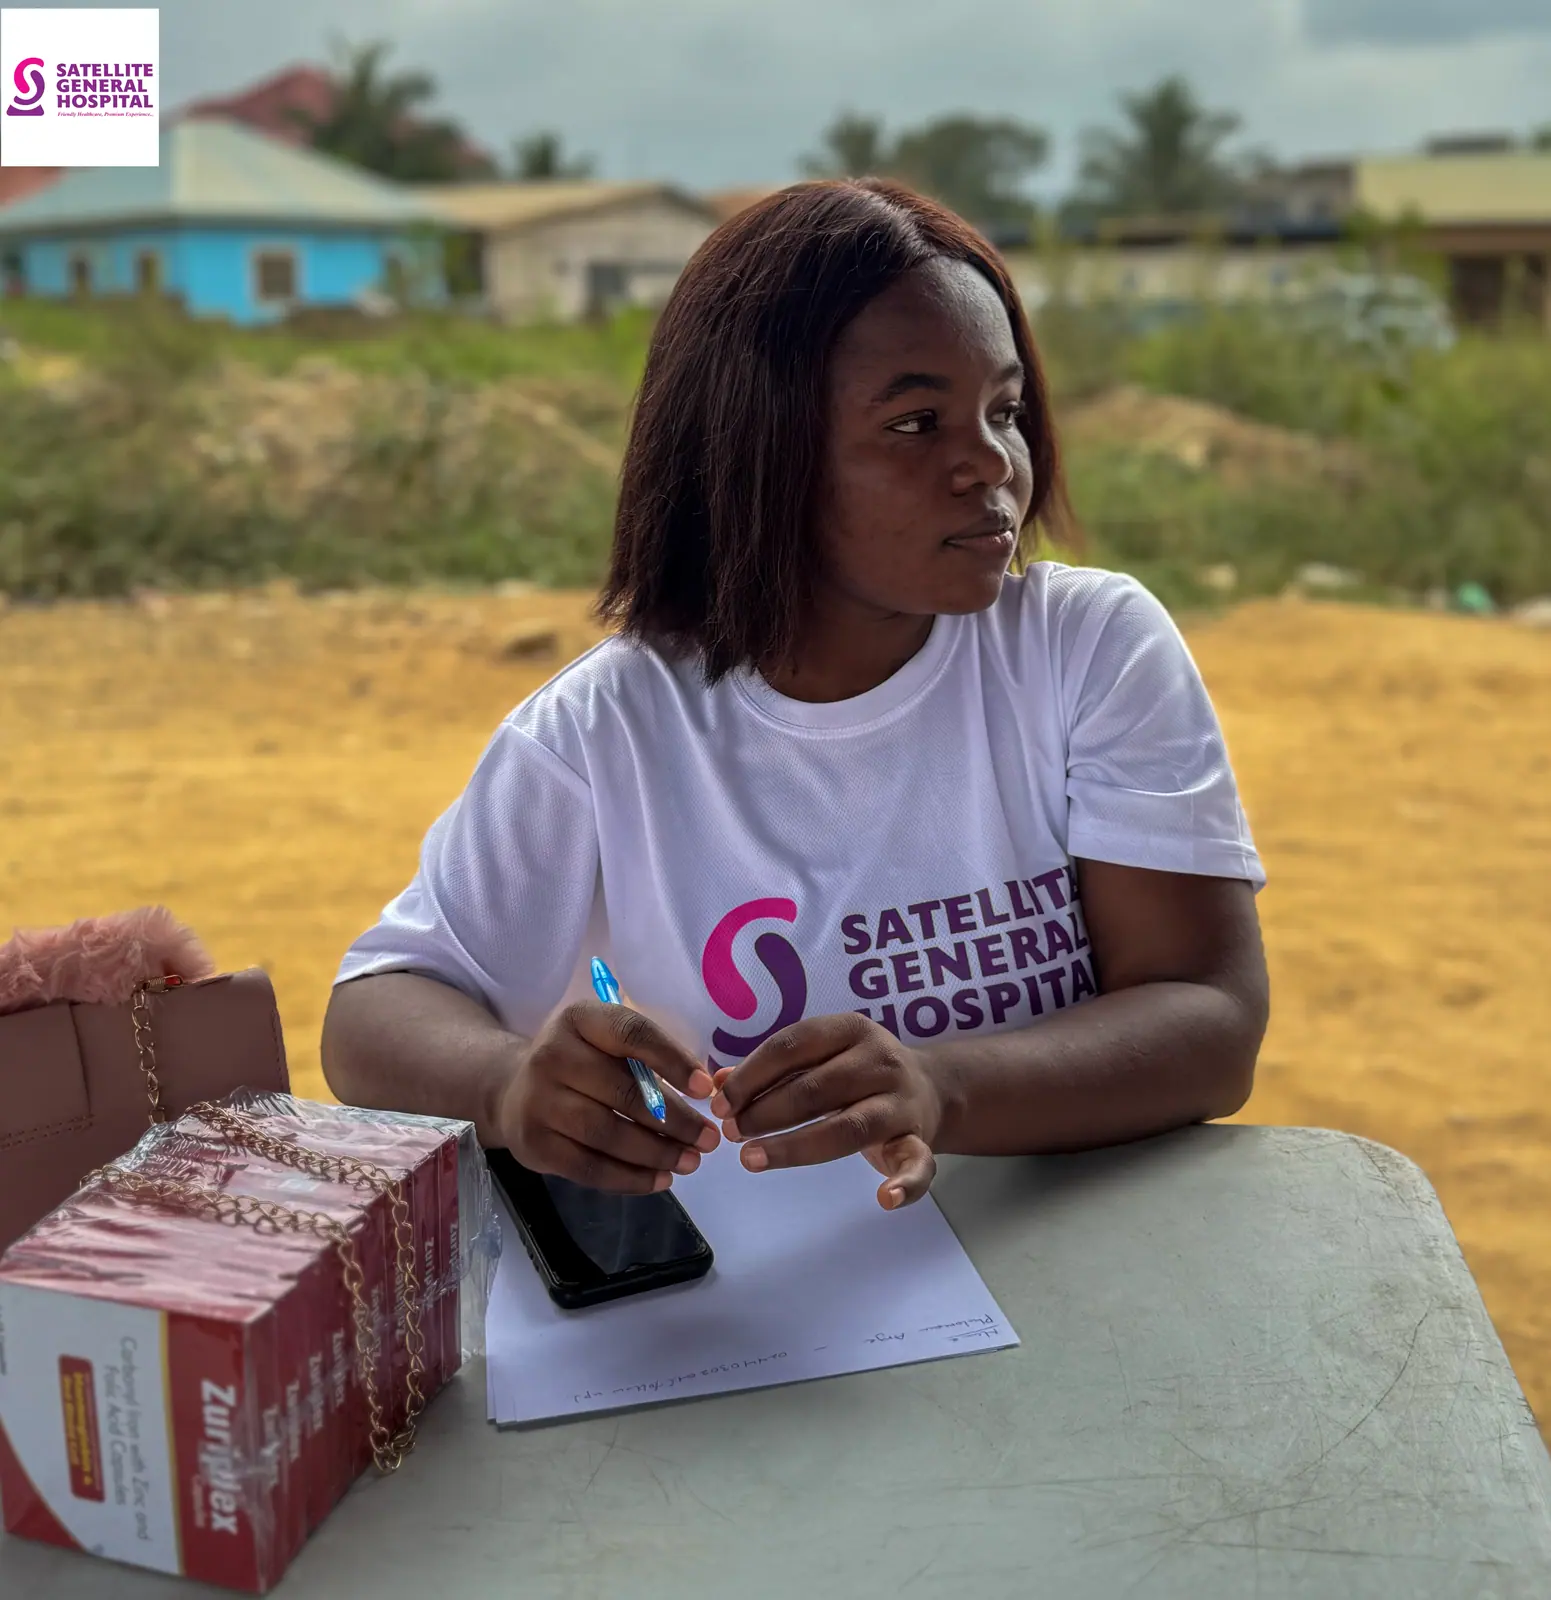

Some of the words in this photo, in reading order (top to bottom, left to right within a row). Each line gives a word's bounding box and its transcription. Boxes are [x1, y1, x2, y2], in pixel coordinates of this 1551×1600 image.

[848, 912, 1088, 999] GENERAL
[201, 1379, 238, 1535] Zuriplex
[135, 1511, 152, 1541] and
